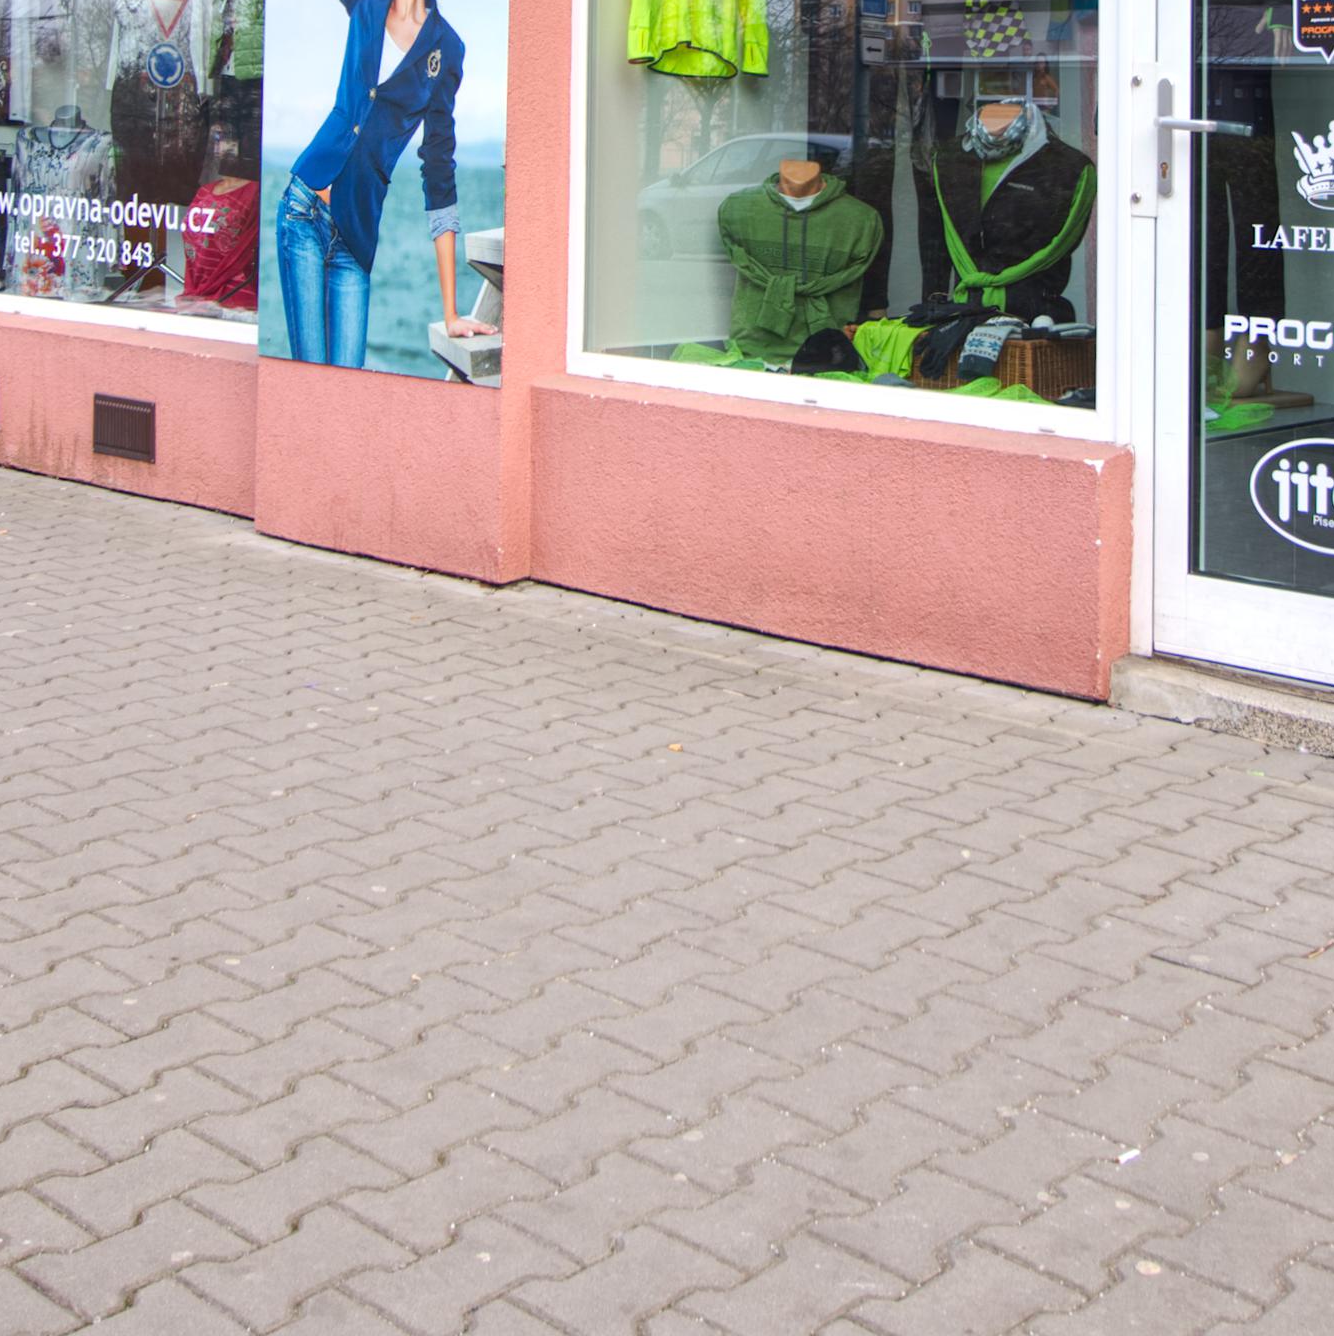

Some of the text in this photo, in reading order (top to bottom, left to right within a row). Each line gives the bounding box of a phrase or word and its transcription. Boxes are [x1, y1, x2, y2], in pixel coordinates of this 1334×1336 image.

[52, 233, 81, 259] 377
[86, 239, 116, 263] 320
[121, 240, 153, 268] 843
